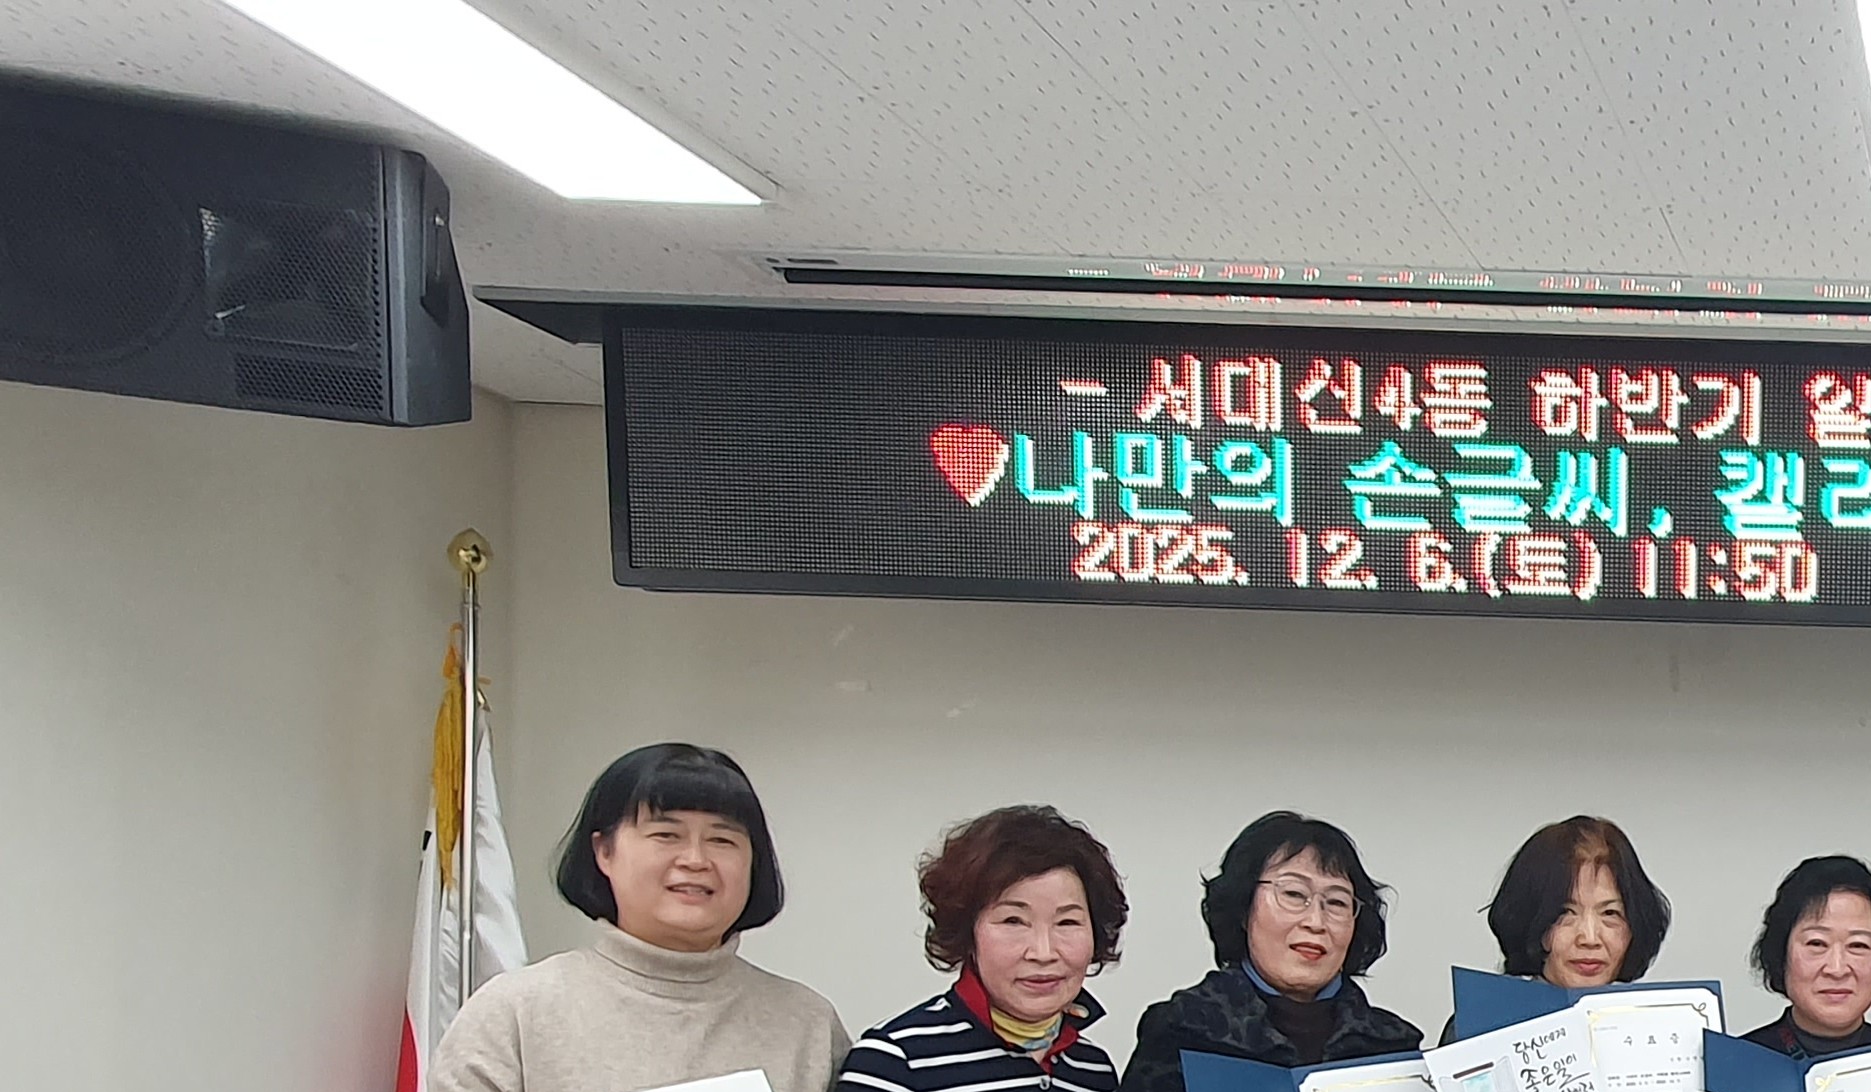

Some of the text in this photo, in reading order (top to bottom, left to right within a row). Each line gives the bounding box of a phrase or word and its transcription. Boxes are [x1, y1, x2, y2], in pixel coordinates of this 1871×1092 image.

[1137, 354, 1492, 437] 서대신4동
[1530, 366, 1763, 445] 하반기
[1014, 430, 1294, 527] 나만의
[1344, 439, 1674, 538] 손글씨,
[1070, 520, 1249, 586] 2025.
[1286, 527, 1378, 589] 12.
[1410, 530, 1602, 601] 6.(토)
[1633, 536, 1817, 602] 11:50
